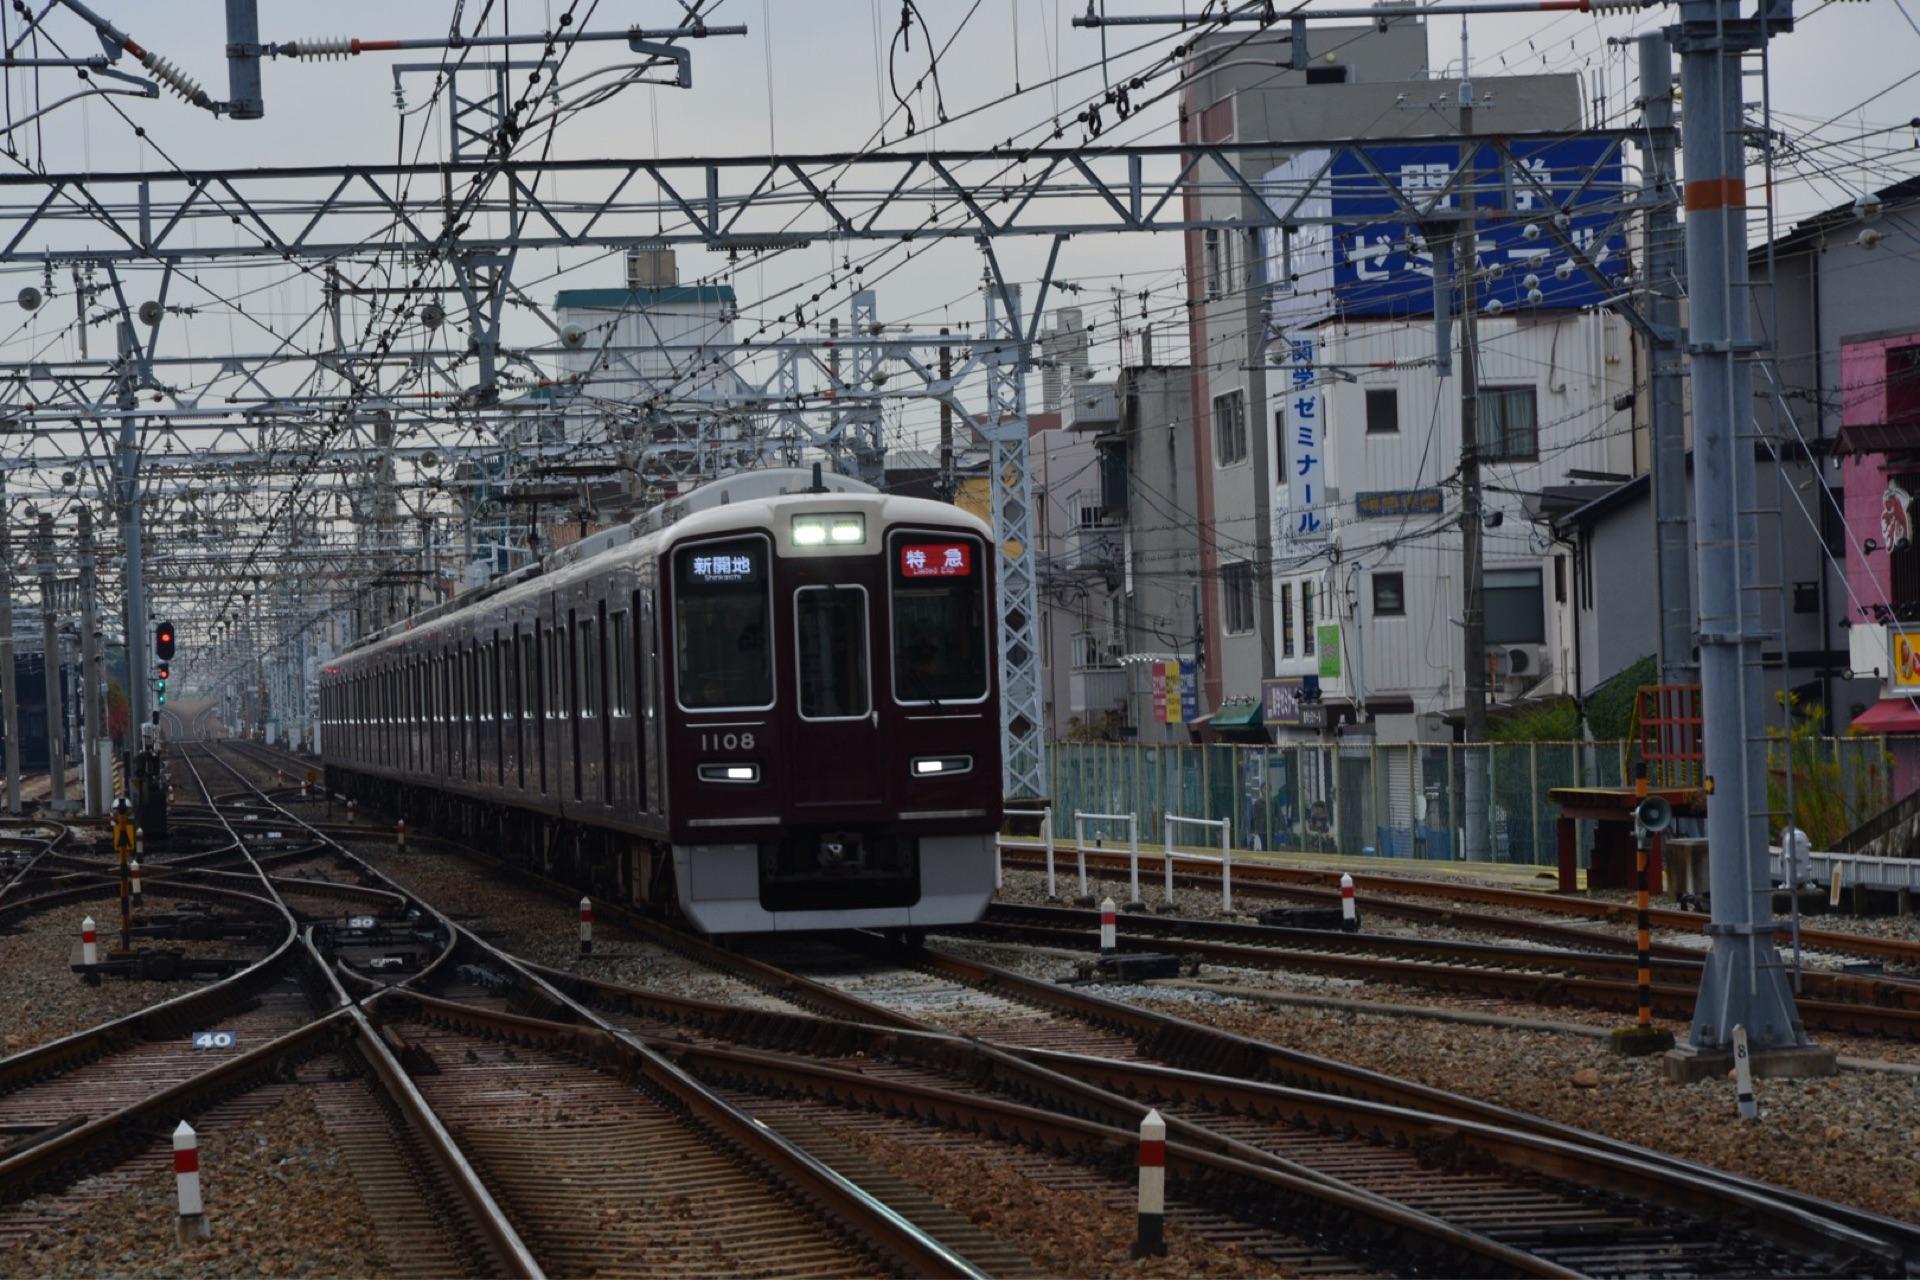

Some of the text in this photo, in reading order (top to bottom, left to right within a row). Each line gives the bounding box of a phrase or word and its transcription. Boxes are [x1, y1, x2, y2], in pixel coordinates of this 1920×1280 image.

[1291, 339, 1320, 533] 関学ゼミナール
[693, 555, 751, 575] 新開地
[906, 548, 964, 568] 特急
[702, 732, 755, 751] 1108
[196, 1032, 231, 1048] 40
[1737, 1044, 1746, 1058] 8
